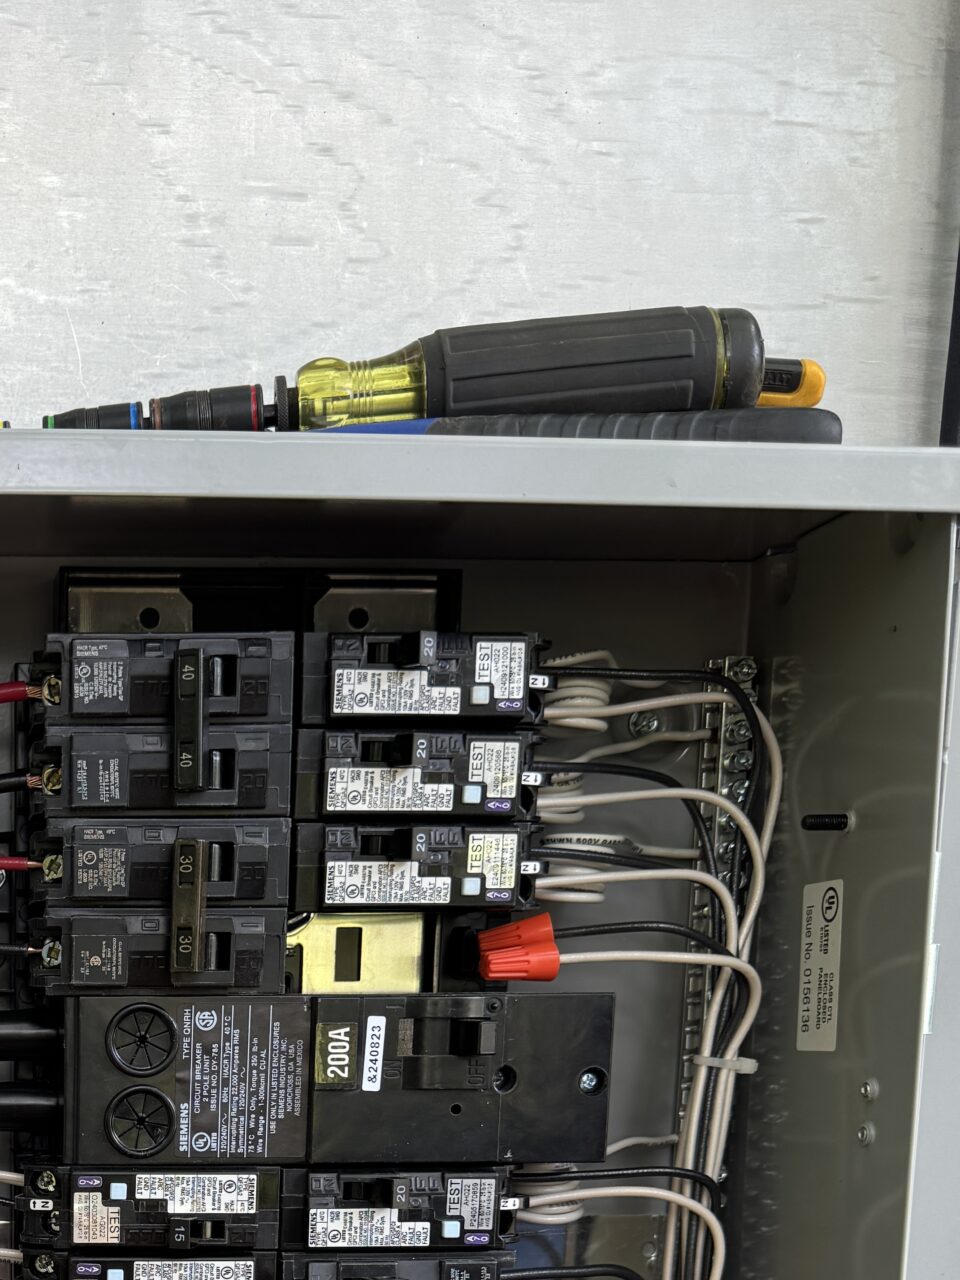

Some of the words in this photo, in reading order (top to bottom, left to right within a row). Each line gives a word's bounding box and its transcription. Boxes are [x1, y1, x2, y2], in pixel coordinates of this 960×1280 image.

[424, 637, 434, 657] 20
[478, 644, 490, 680] TEST
[182, 665, 194, 680] 40
[335, 673, 343, 709] SIEMENS
[179, 752, 192, 767] 40
[417, 739, 427, 758] 20
[471, 743, 483, 780] TEST
[328, 771, 337, 808] SIEMENS
[416, 834, 426, 852] 20
[470, 836, 482, 871] TEST
[179, 855, 193, 873] 30
[327, 866, 335, 901] SIEMENS
[805, 904, 814, 938] Issue
[179, 935, 192, 953] 30
[804, 942, 812, 964] No.
[801, 968, 812, 1033] 0156136
[183, 1009, 191, 1035] QNRH
[326, 1027, 350, 1078] 200A
[368, 1025, 381, 1083] &240823
[384, 1060, 402, 1079] ON
[180, 1103, 188, 1152] SIEMENS
[237, 1115, 245, 1153] Symmetrical
[257, 1116, 265, 1136] Range
[397, 1185, 406, 1202] 20
[448, 1180, 461, 1213] TEST
[109, 1209, 120, 1241] TEST
[174, 1226, 185, 1242] 15
